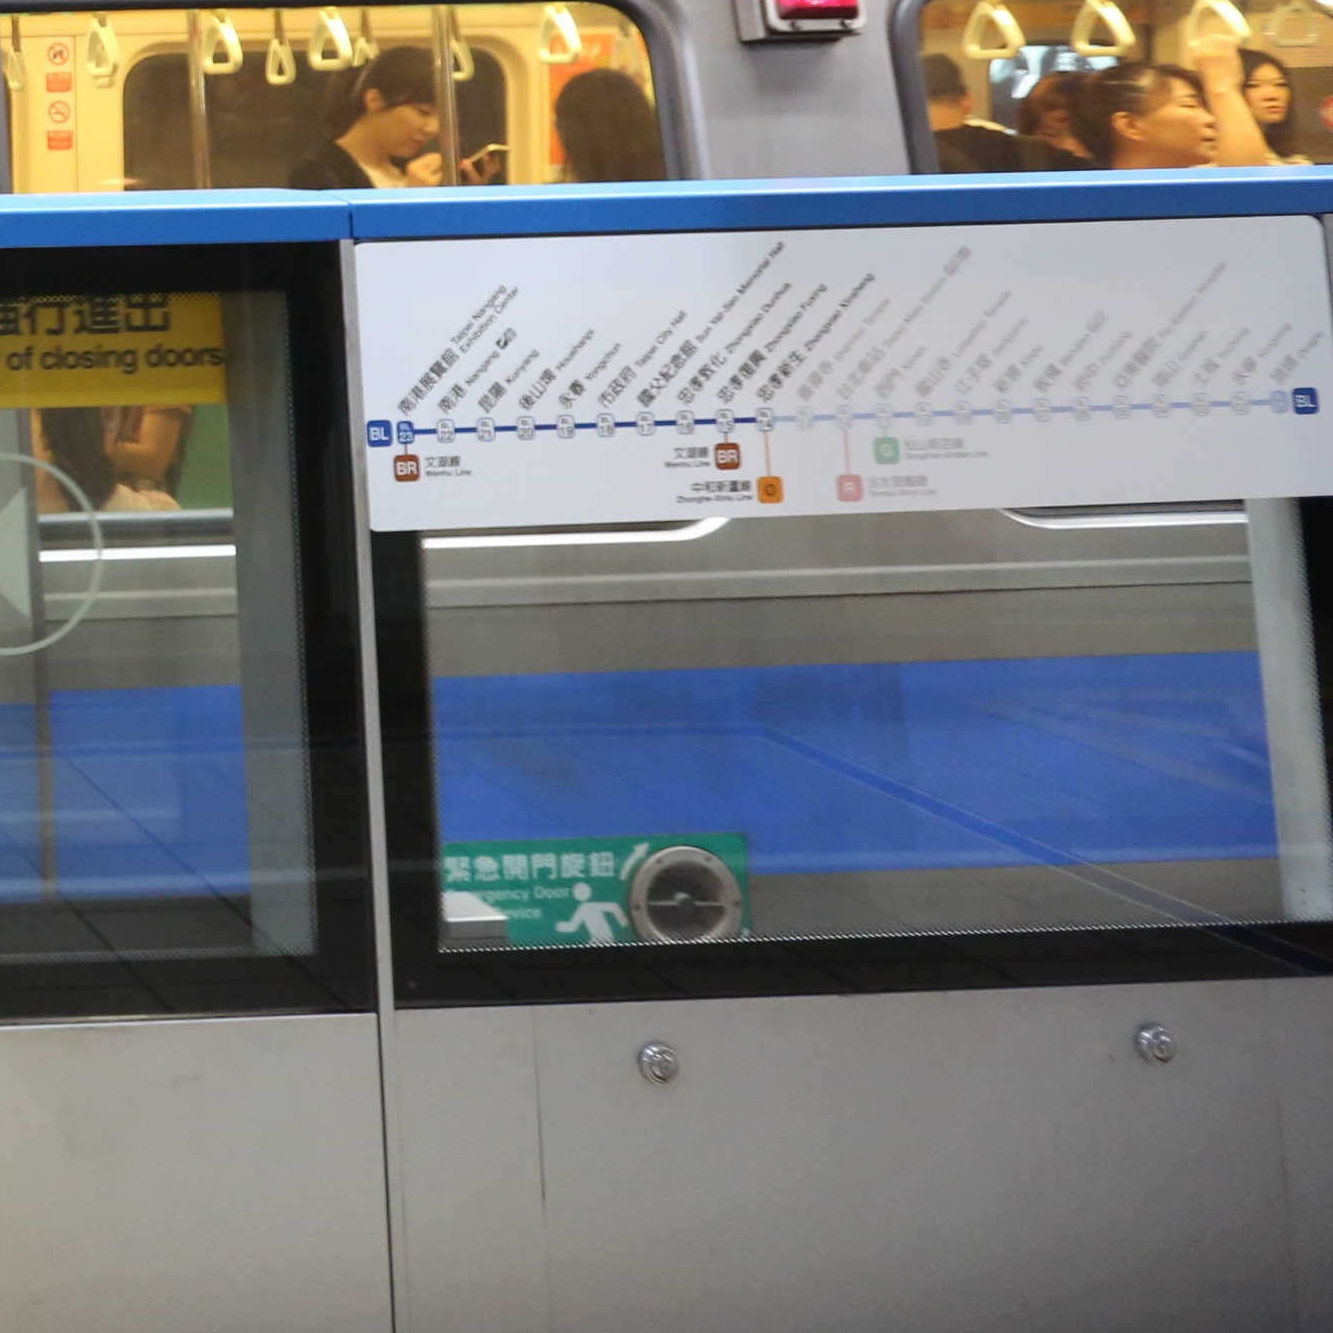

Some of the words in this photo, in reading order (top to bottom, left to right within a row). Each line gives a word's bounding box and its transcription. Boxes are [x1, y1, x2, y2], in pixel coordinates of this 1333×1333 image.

[5, 345, 34, 370] of
[38, 345, 137, 374] closing
[144, 343, 222, 367] doors
[369, 426, 390, 442] BL
[399, 432, 414, 443] 23
[440, 431, 454, 441] 22
[717, 450, 740, 463] BR
[396, 461, 418, 476] BR
[534, 885, 570, 899] Door
